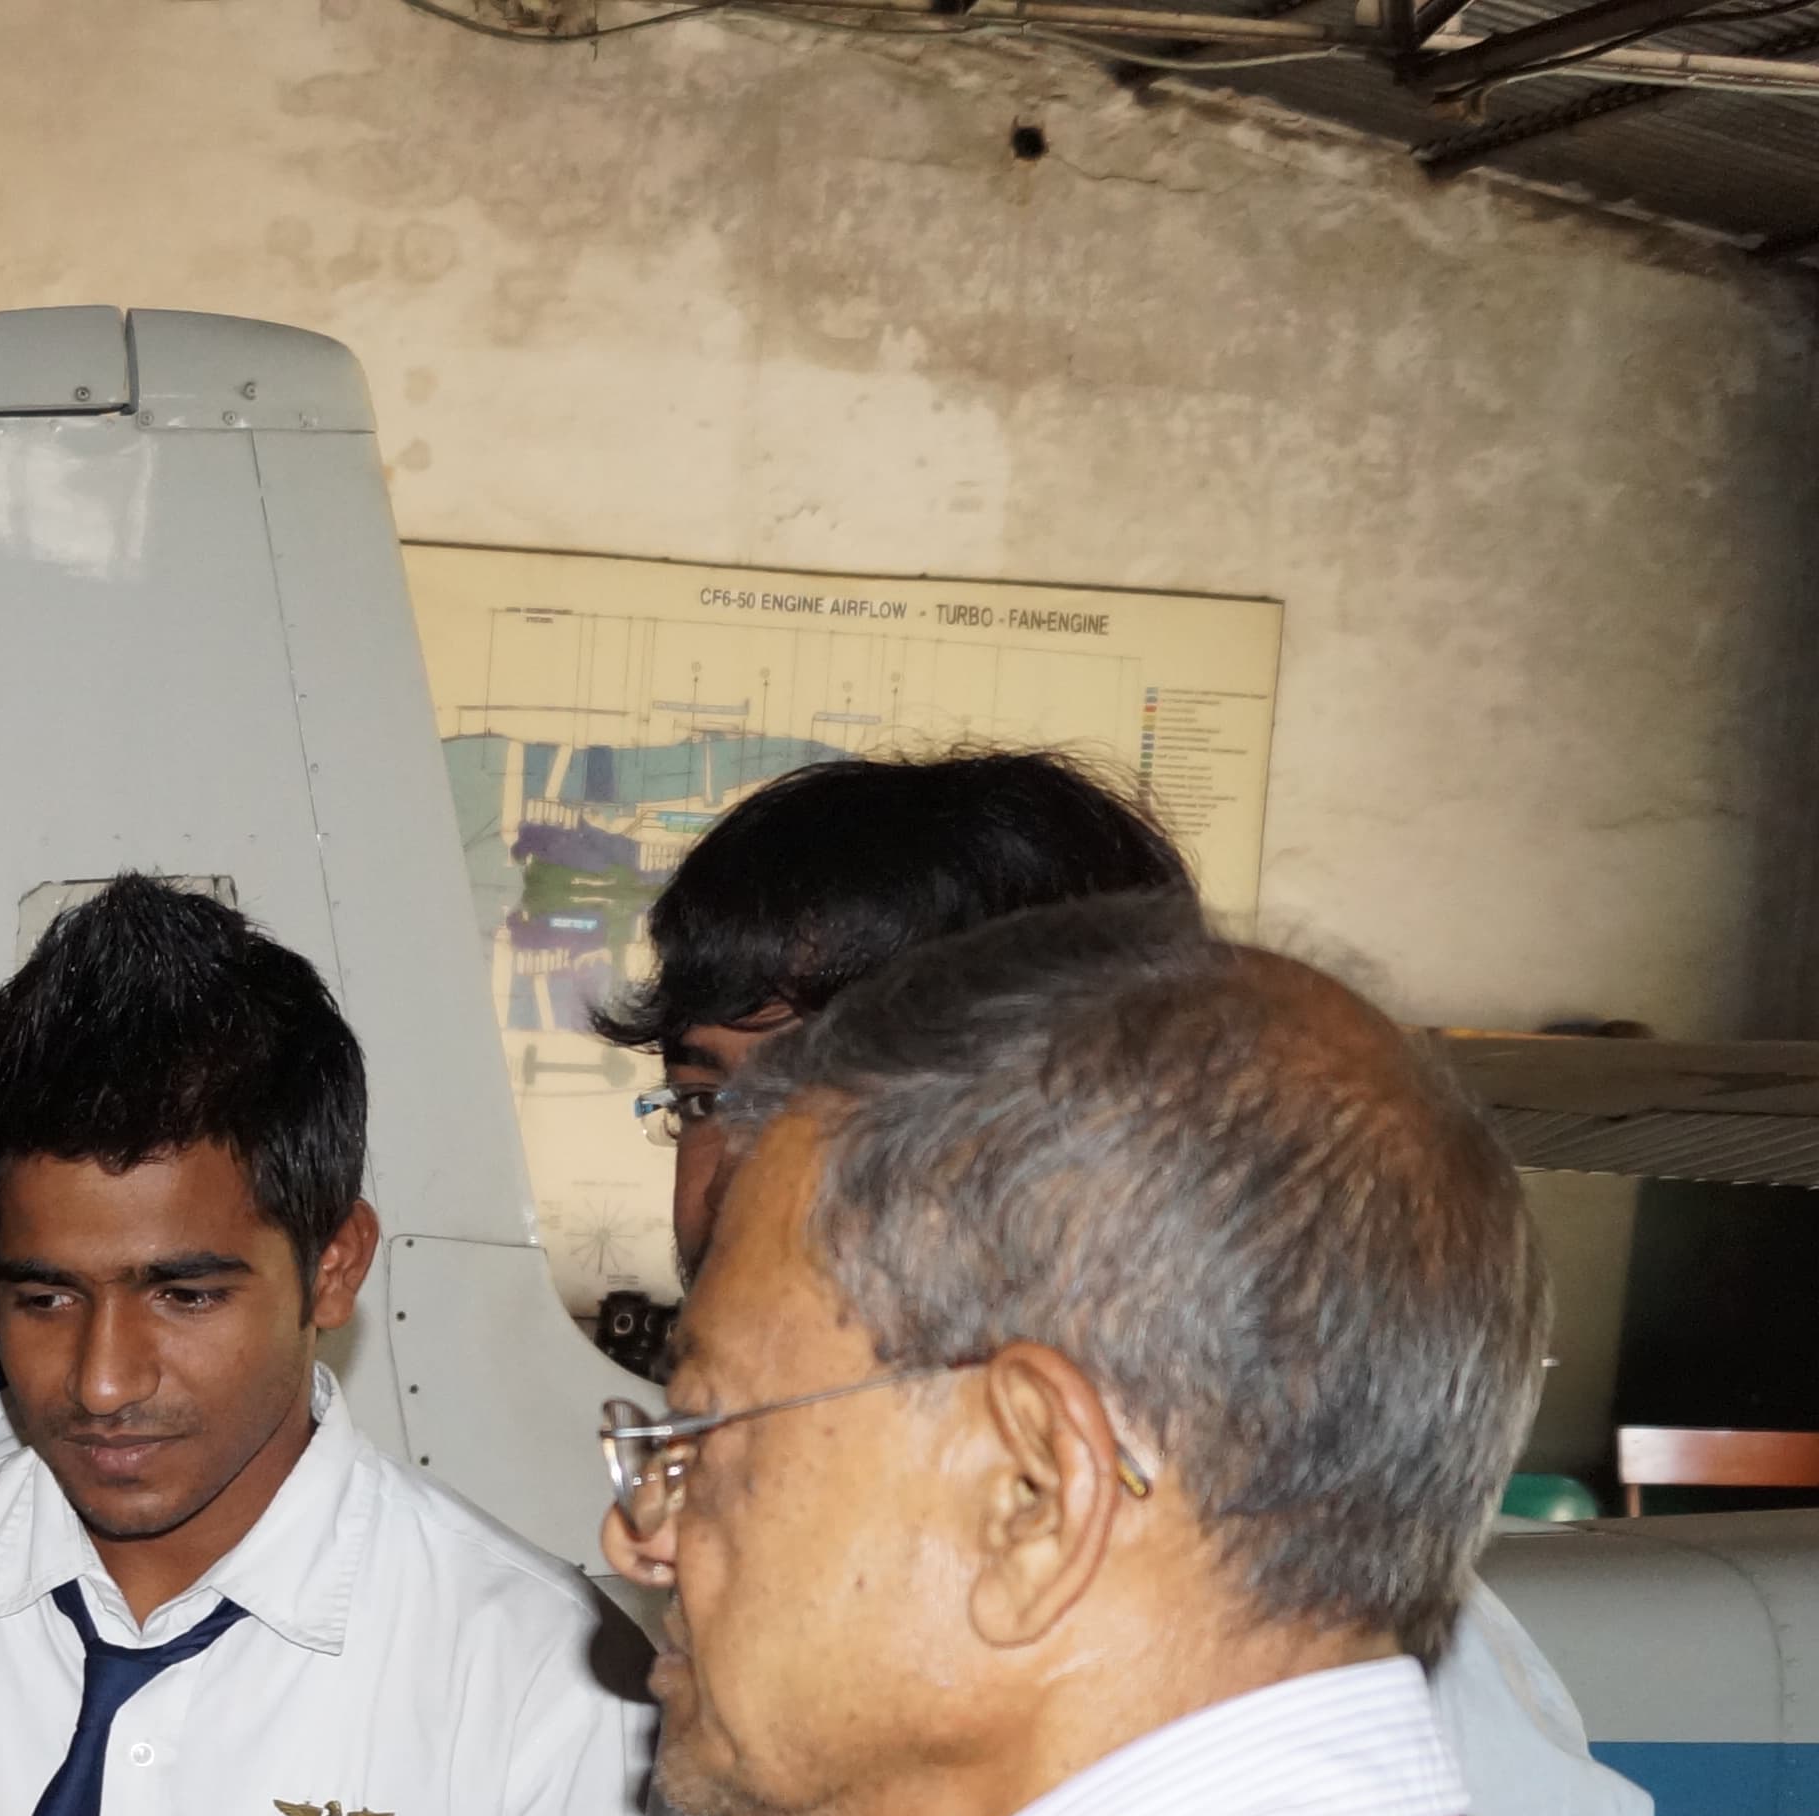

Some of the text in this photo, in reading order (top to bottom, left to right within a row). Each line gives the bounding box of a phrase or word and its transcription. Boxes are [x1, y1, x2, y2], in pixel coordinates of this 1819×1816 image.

[699, 588, 757, 611] CF6-50
[761, 596, 825, 616] ENGINE
[829, 598, 908, 620] AIRFLOW
[935, 603, 994, 629] TURBO
[1008, 606, 1110, 636] FAN-ENGINE
